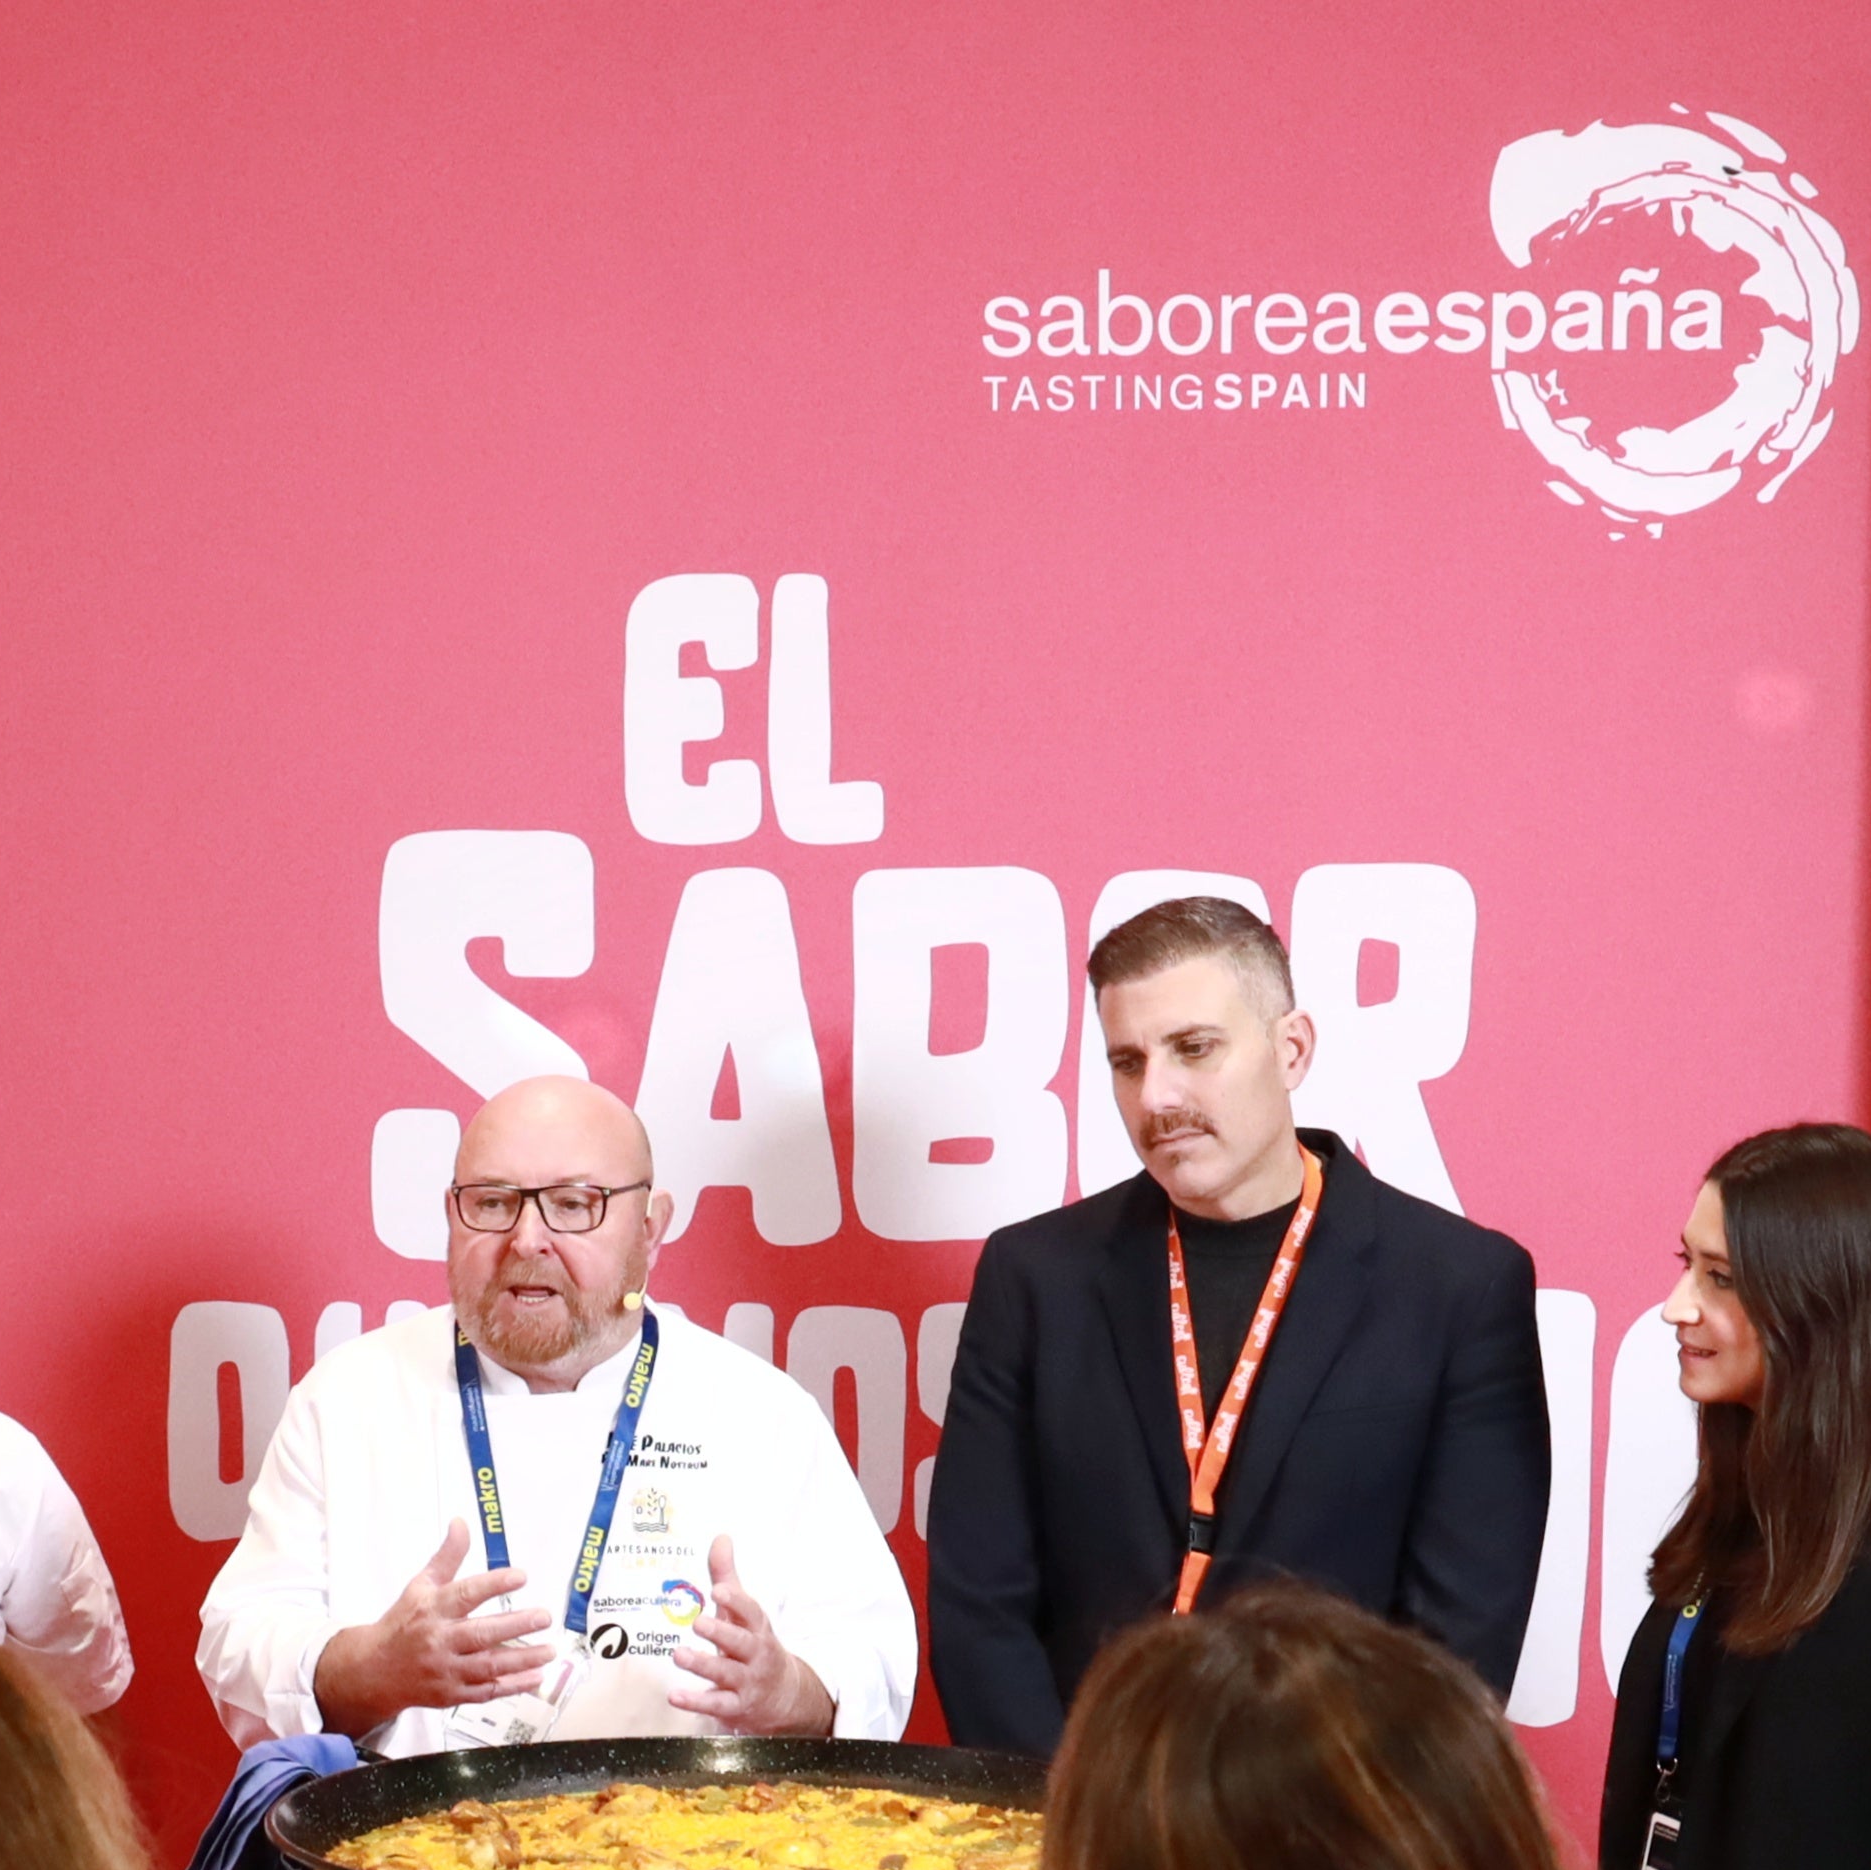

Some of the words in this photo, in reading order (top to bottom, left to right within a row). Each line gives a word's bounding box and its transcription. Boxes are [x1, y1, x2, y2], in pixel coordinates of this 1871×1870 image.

[982, 267, 1724, 370] saboreaespaña
[982, 371, 1368, 412] TASTINGSPAIN
[624, 572, 885, 846] EL
[626, 1342, 655, 1409] makro
[641, 1434, 703, 1456] PALACIOS
[477, 1466, 503, 1534] makro
[574, 1525, 605, 1593] makro
[636, 1630, 681, 1646] origen
